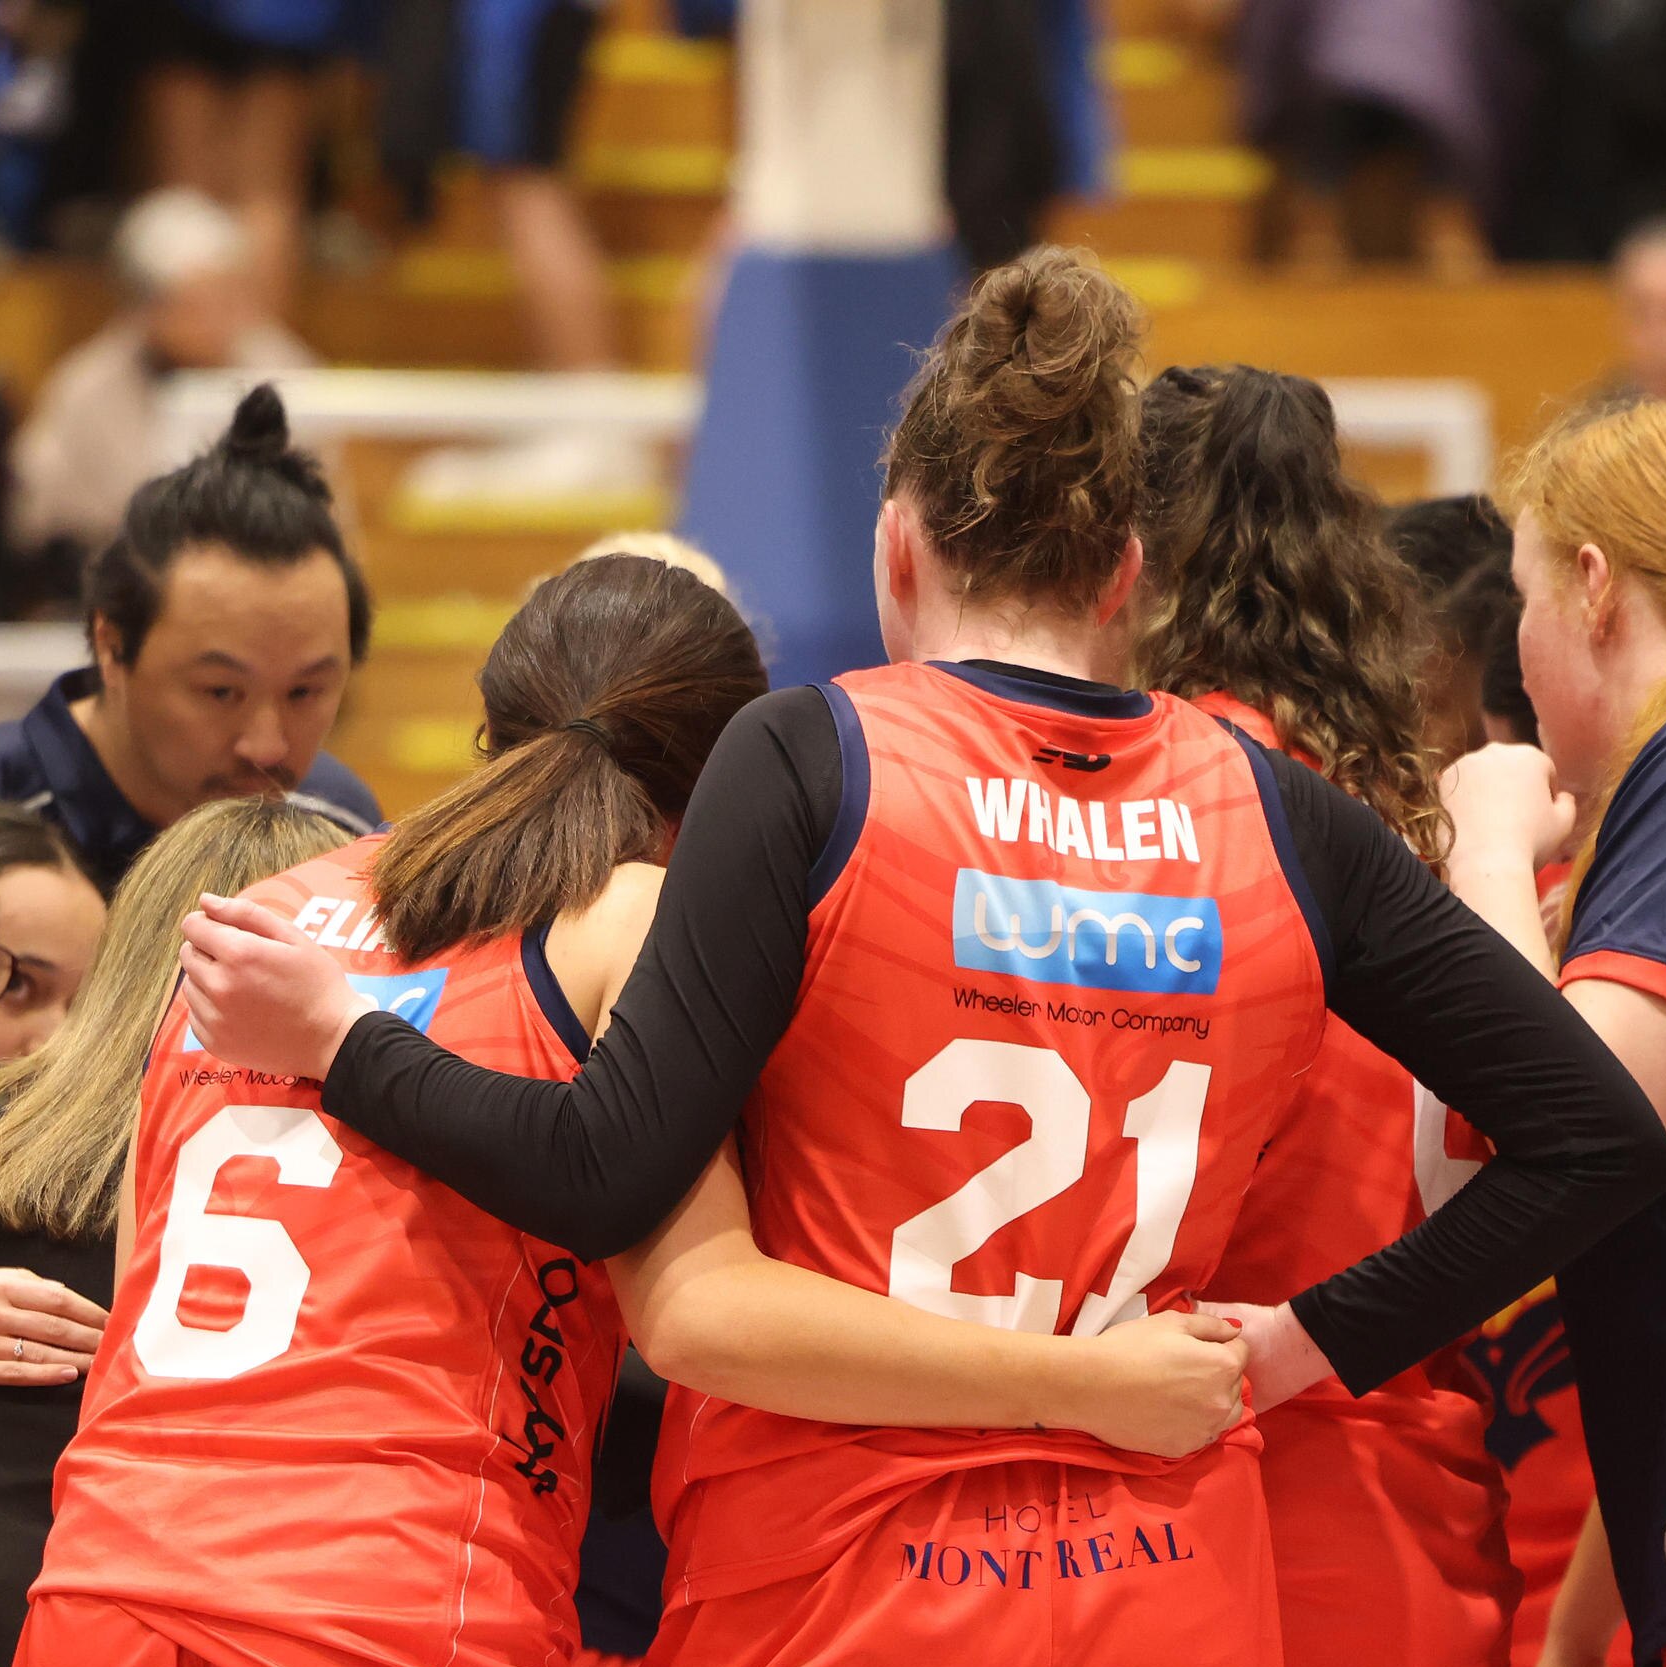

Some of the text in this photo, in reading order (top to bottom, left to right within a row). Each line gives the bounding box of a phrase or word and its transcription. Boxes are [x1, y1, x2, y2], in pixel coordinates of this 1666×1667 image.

[965, 776, 1201, 863] WHALEN
[292, 896, 397, 952] ELIA
[973, 891, 1202, 974] wmc
[954, 988, 1210, 1040] Wheeler Motor Company
[889, 1038, 1213, 1336] 21
[134, 1105, 344, 1379] 6
[985, 1493, 1107, 1533] HOEL
[896, 1522, 1194, 1590] MONTREAL
